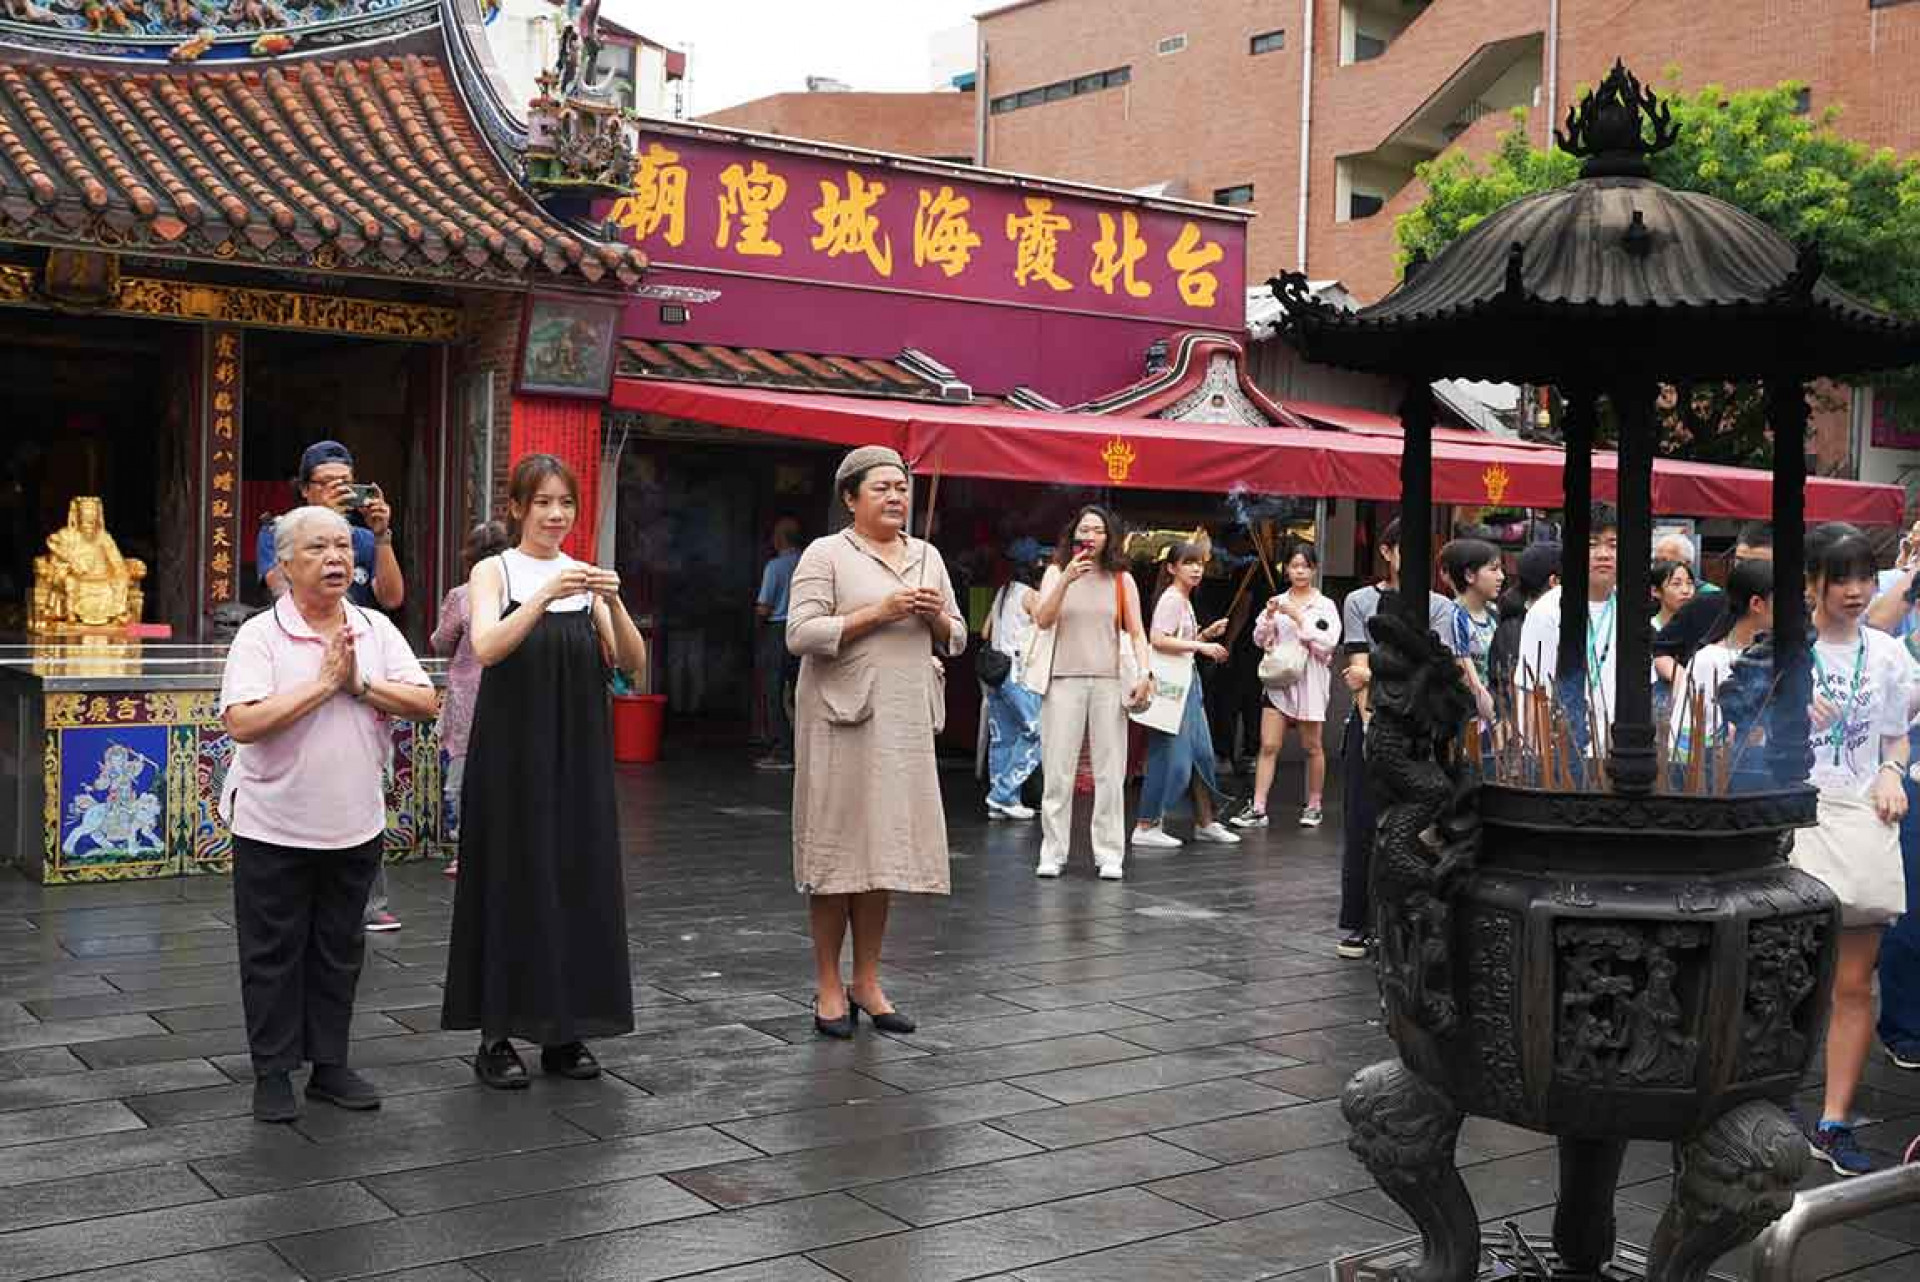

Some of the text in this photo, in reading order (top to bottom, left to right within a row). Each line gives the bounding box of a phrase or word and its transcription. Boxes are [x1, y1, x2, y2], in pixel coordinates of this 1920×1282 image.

[612, 143, 1222, 308] 台北霞海城隍廟
